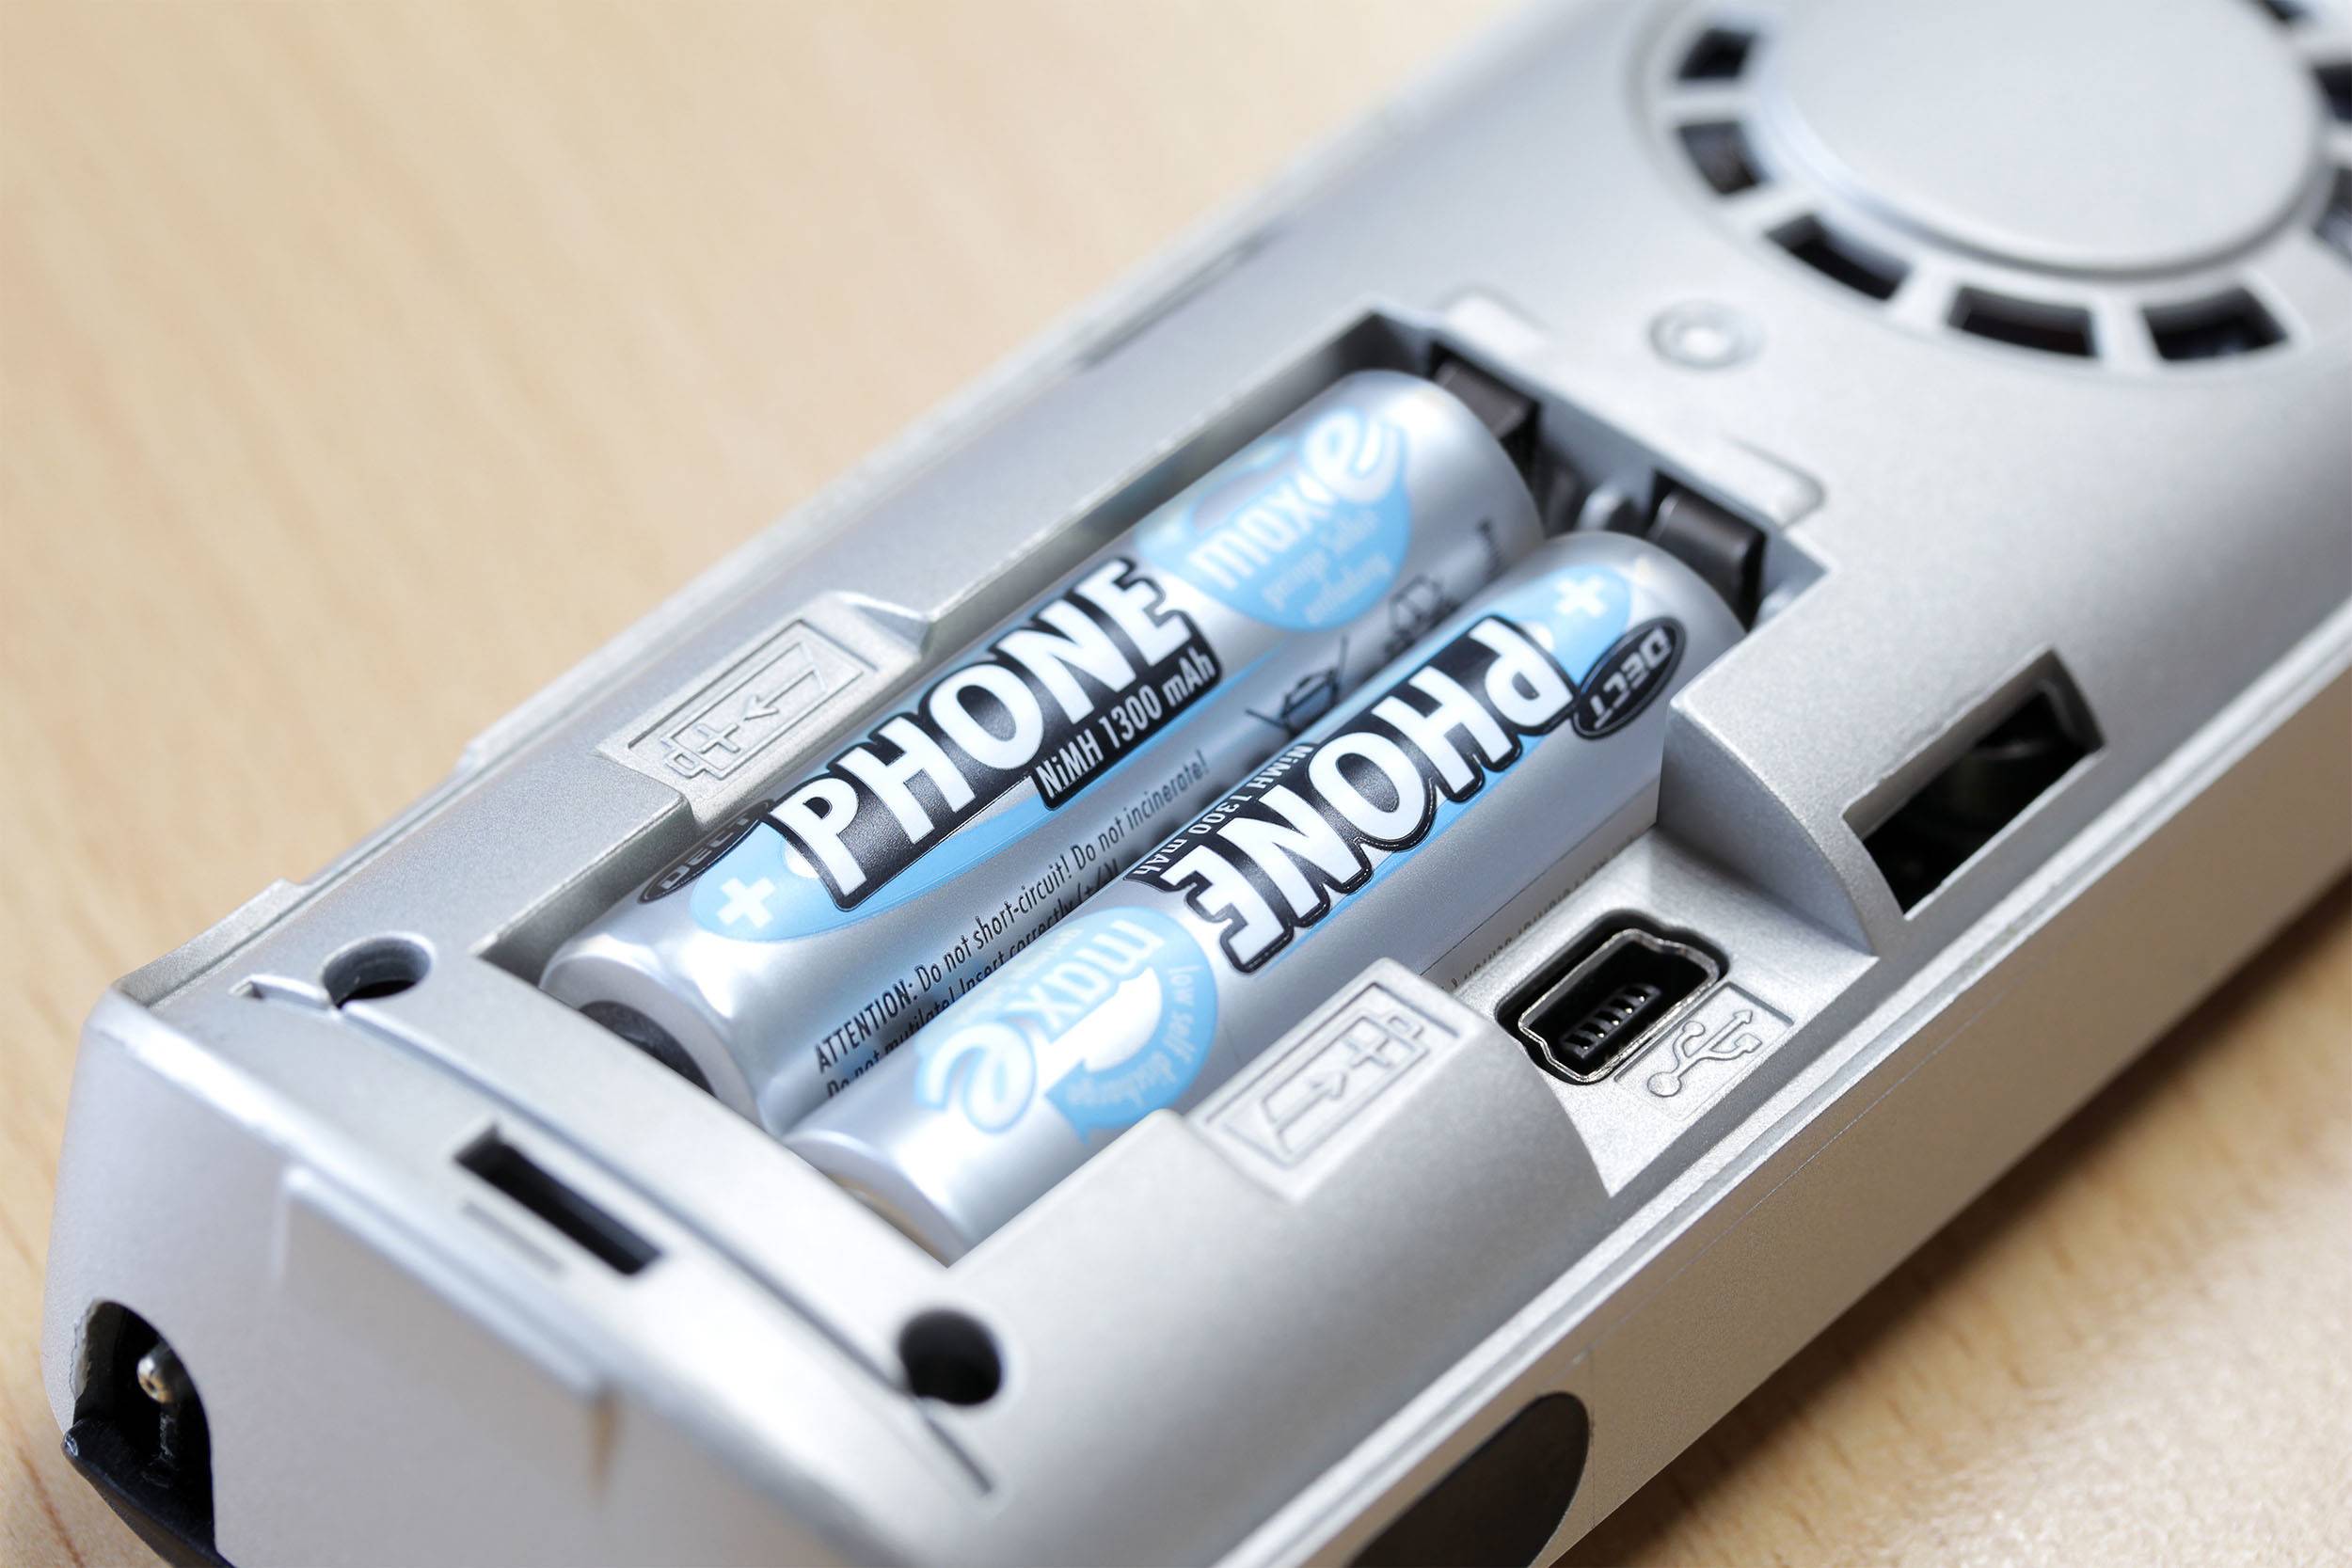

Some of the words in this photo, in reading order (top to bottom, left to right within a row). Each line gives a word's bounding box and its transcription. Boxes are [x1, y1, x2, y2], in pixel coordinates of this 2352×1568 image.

[770, 559, 1192, 896] PHONE
[1035, 728, 1104, 800] NiMH
[1098, 684, 1163, 750] 1300
[1162, 646, 1216, 707] mAh
[1590, 626, 1673, 730] DECT
[1159, 618, 1574, 965] PHONE
[1187, 794, 1253, 836] 1300
[1246, 744, 1315, 790] NiMH
[660, 811, 750, 890] DECT
[1133, 837, 1188, 875] mAh
[815, 979, 918, 1074] ATTENTION:
[914, 963, 942, 992] Do
[942, 934, 972, 974] not
[972, 853, 1073, 950] short-circuit!
[1070, 844, 1097, 871] Do
[1097, 816, 1125, 853] not
[1123, 749, 1209, 831] incinerate!
